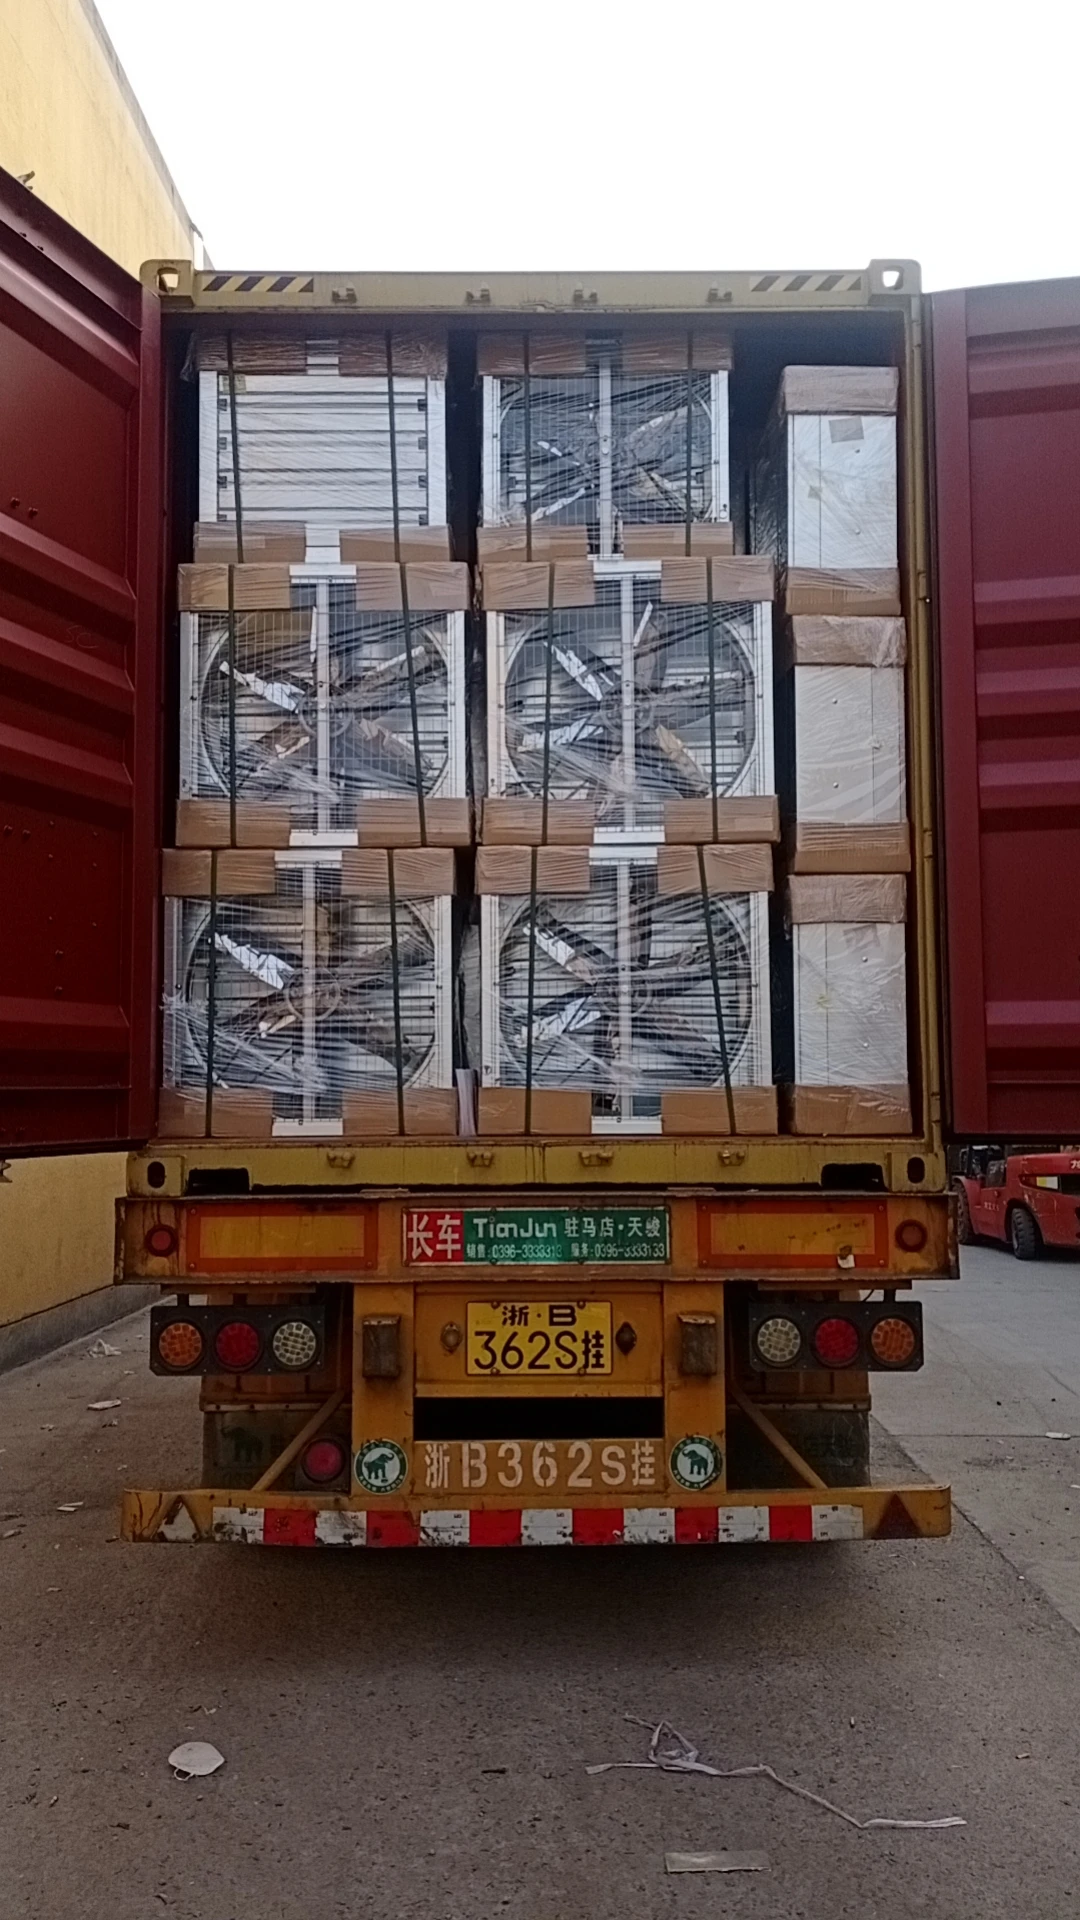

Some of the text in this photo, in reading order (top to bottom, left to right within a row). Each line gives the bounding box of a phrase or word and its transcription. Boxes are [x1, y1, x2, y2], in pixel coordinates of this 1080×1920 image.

[407, 1214, 461, 1259] 长车
[474, 1330, 606, 1370] 362S挂
[425, 1441, 656, 1489] 浙B362S挂
